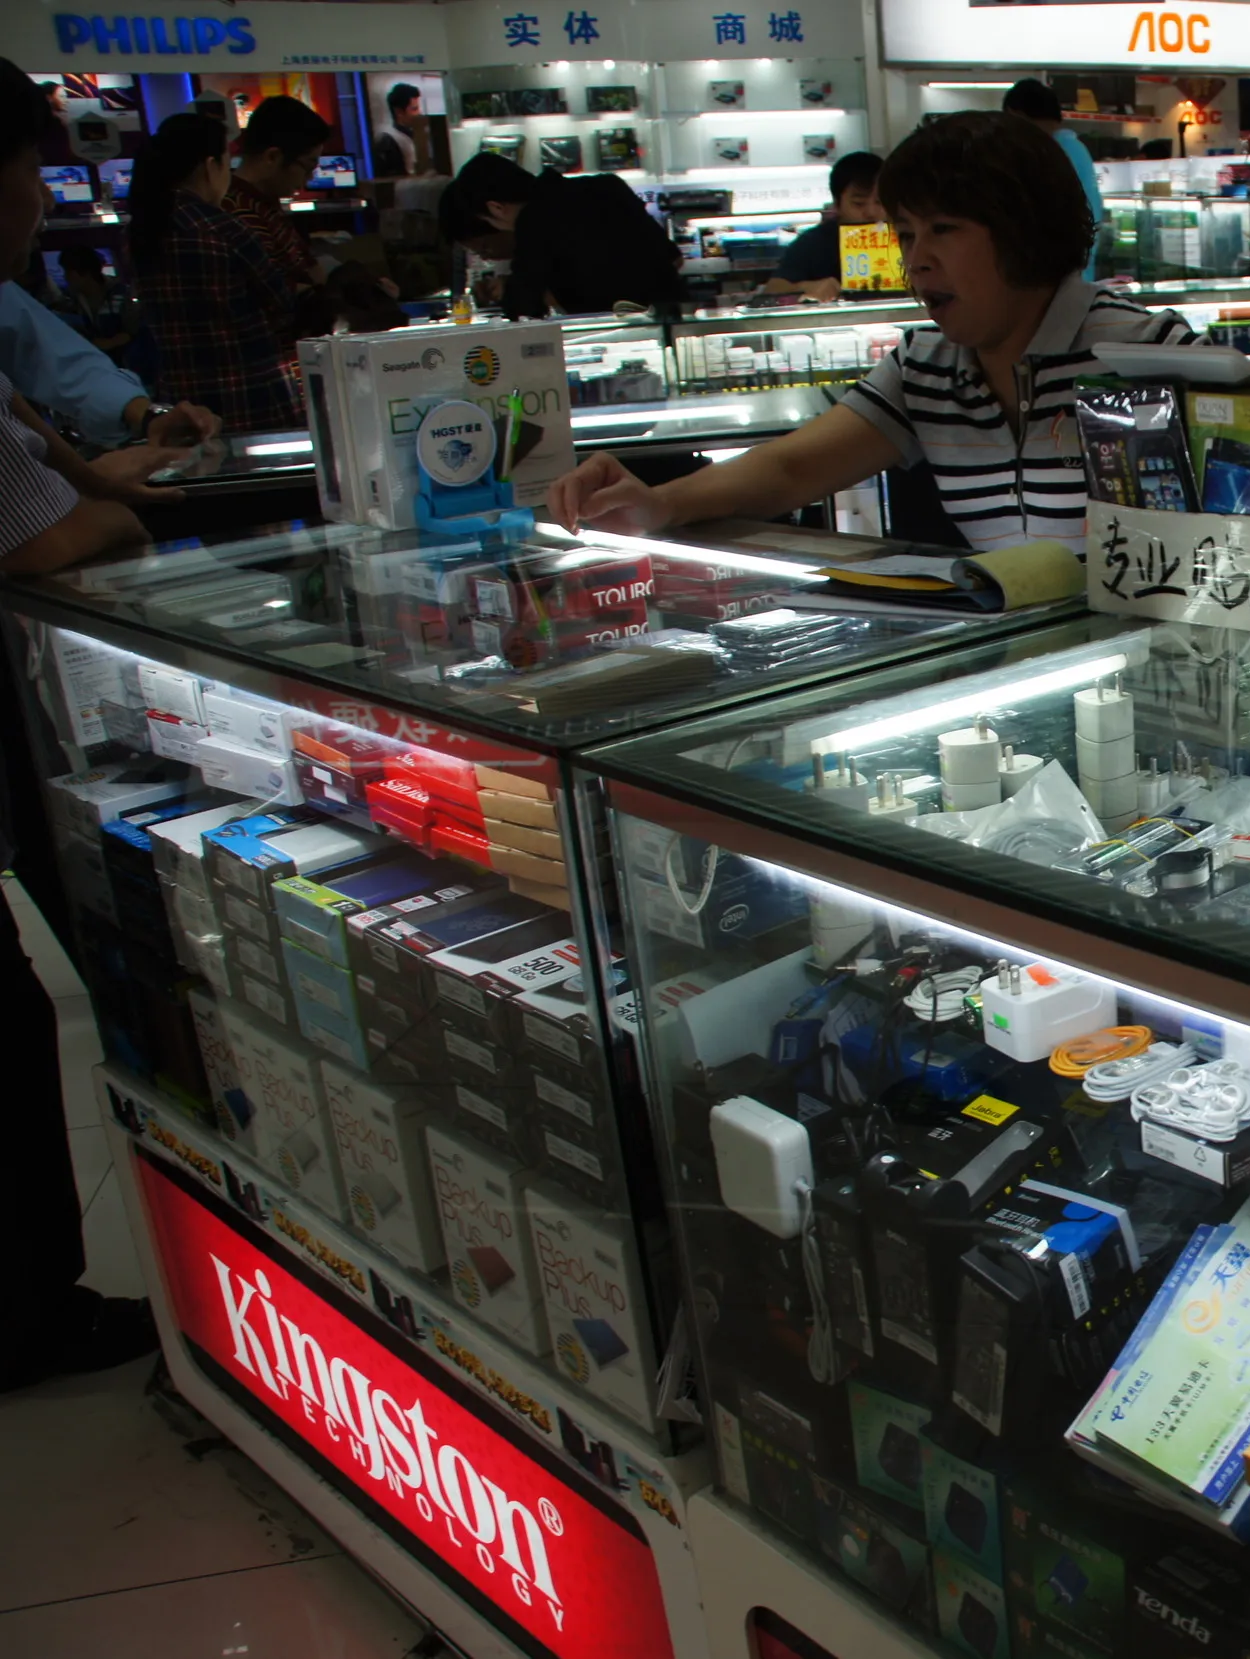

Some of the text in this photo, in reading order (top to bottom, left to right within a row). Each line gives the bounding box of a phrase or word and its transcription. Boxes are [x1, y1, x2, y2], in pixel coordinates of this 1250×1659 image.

[54, 13, 257, 55] PHILIPS
[1127, 11, 1211, 53] AOC
[382, 361, 421, 373] Seagate
[388, 388, 562, 435] Exnson
[525, 955, 566, 977] 500
[329, 1096, 398, 1166] Backup
[971, 1104, 1002, 1119] Jabra
[335, 1128, 376, 1173] Plus
[434, 1163, 513, 1242] Backup
[440, 1199, 483, 1248] Plus
[536, 1229, 626, 1316] Backup
[542, 1267, 593, 1320] Plus
[208, 1251, 563, 1606] Kingston
[276, 1374, 564, 1632] TECHNOLOGY
[1133, 1585, 1213, 1645] Tenda
